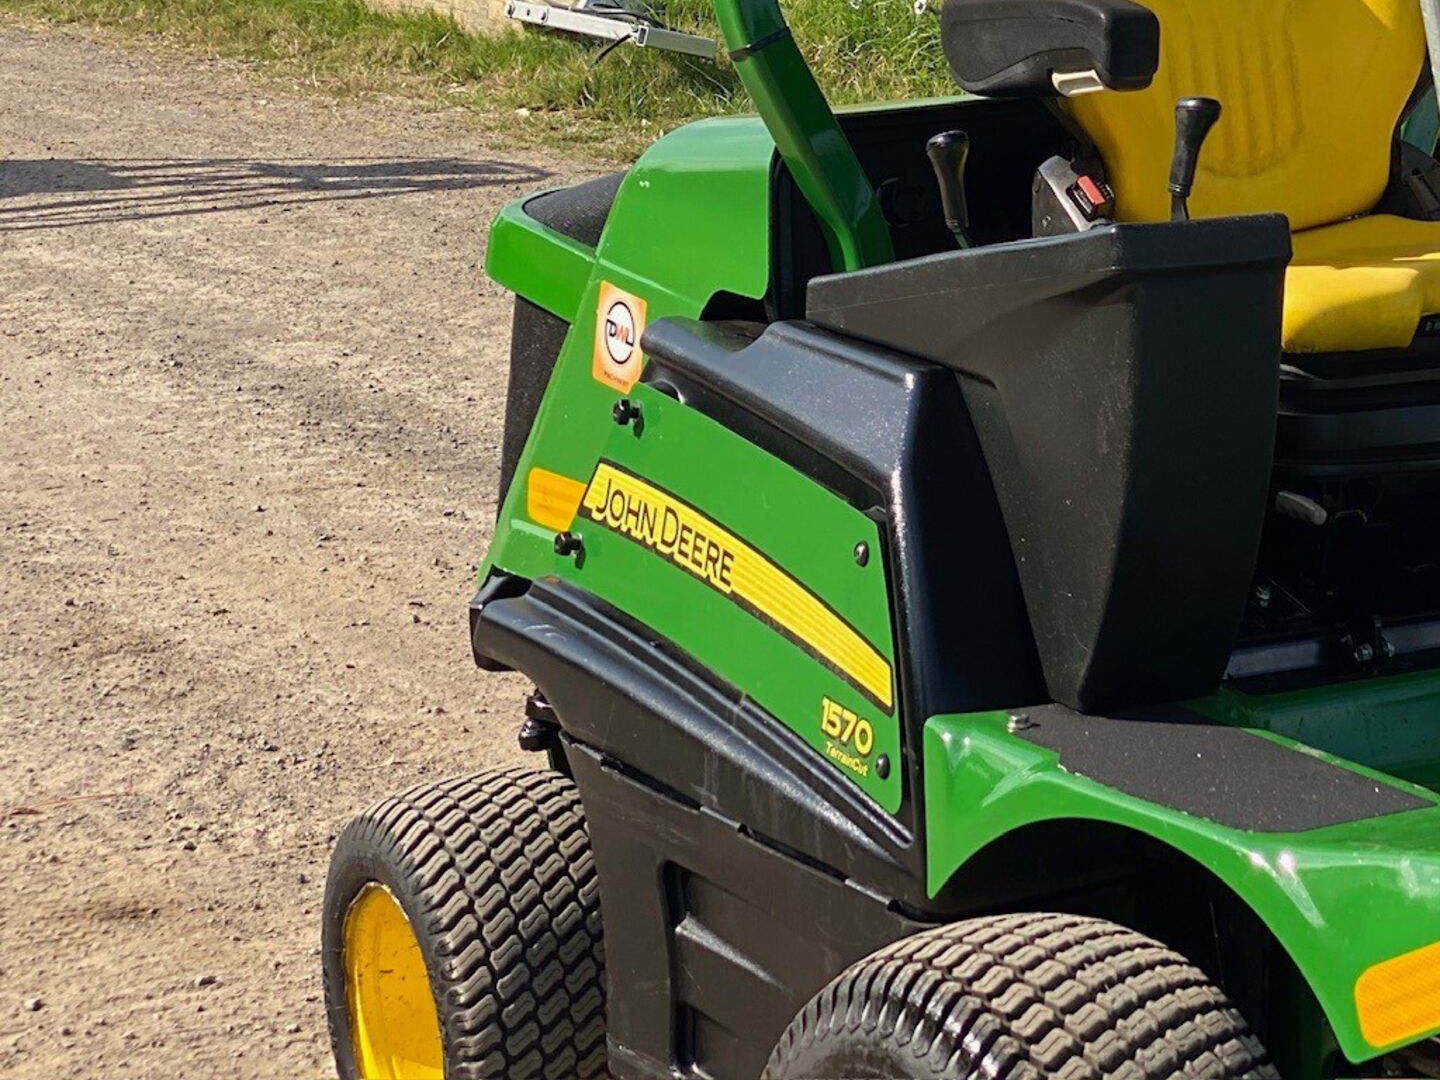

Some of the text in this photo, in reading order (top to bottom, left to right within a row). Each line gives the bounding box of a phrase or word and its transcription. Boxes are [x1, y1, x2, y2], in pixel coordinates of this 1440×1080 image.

[596, 477, 735, 587] JOHN DEERE
[821, 695, 874, 756] 1570
[826, 740, 869, 777] TerrainCut
